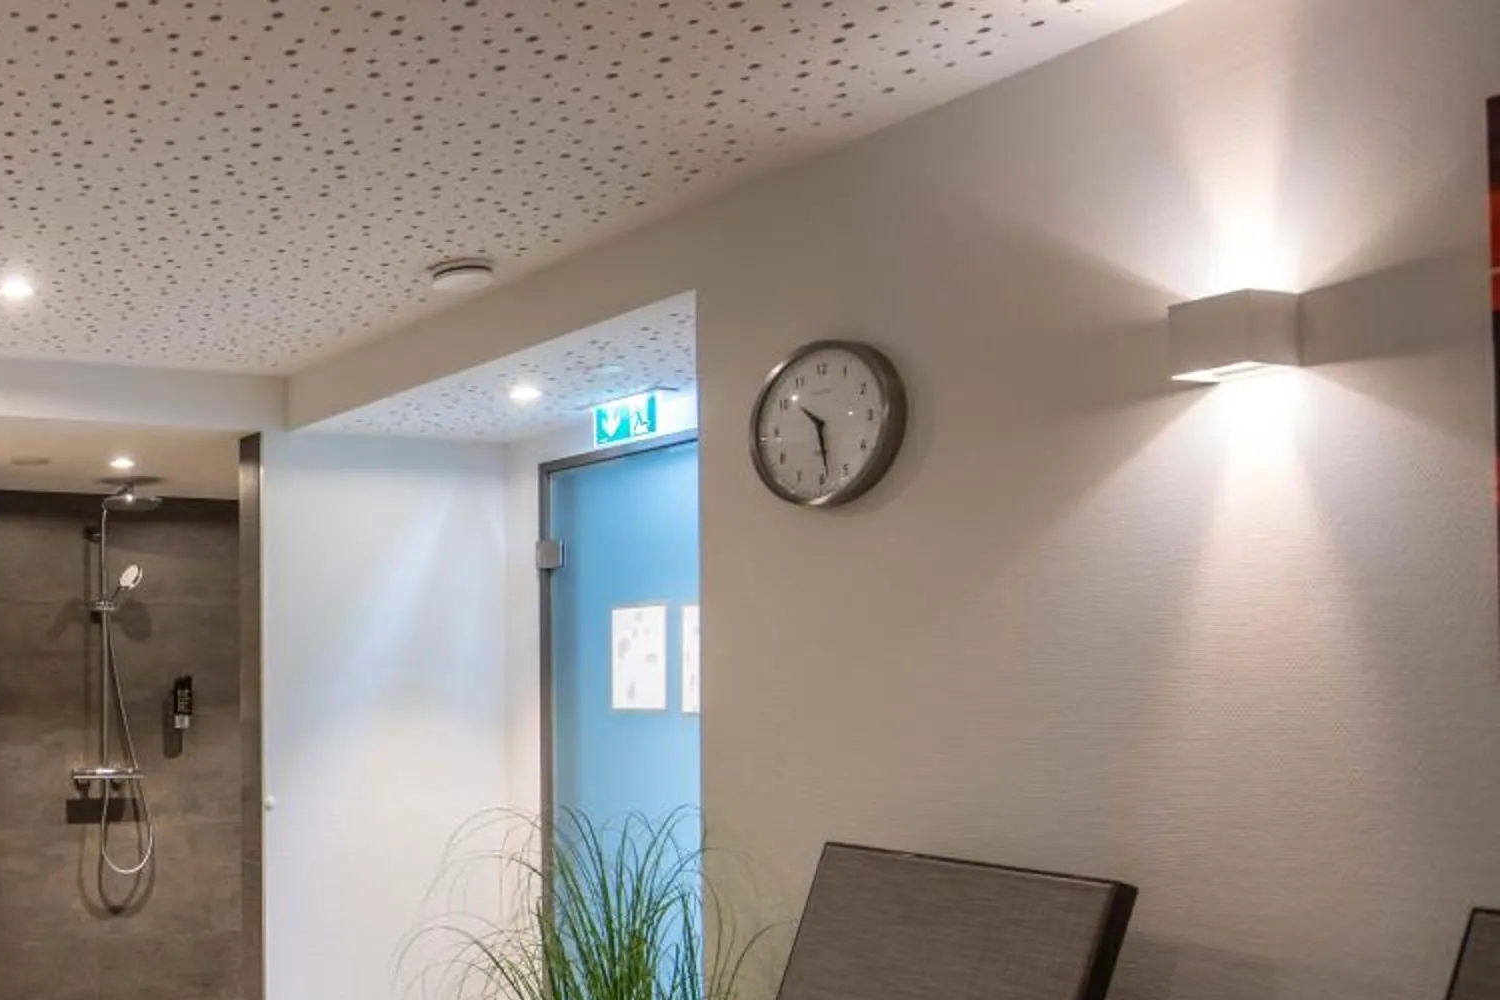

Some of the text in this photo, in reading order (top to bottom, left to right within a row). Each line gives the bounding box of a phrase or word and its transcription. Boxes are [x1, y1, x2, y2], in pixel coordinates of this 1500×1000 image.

[815, 362, 828, 376] 12
[795, 376, 805, 388] 11
[860, 382, 867, 395] 2
[779, 399, 789, 411] 10
[842, 463, 850, 477] 5
